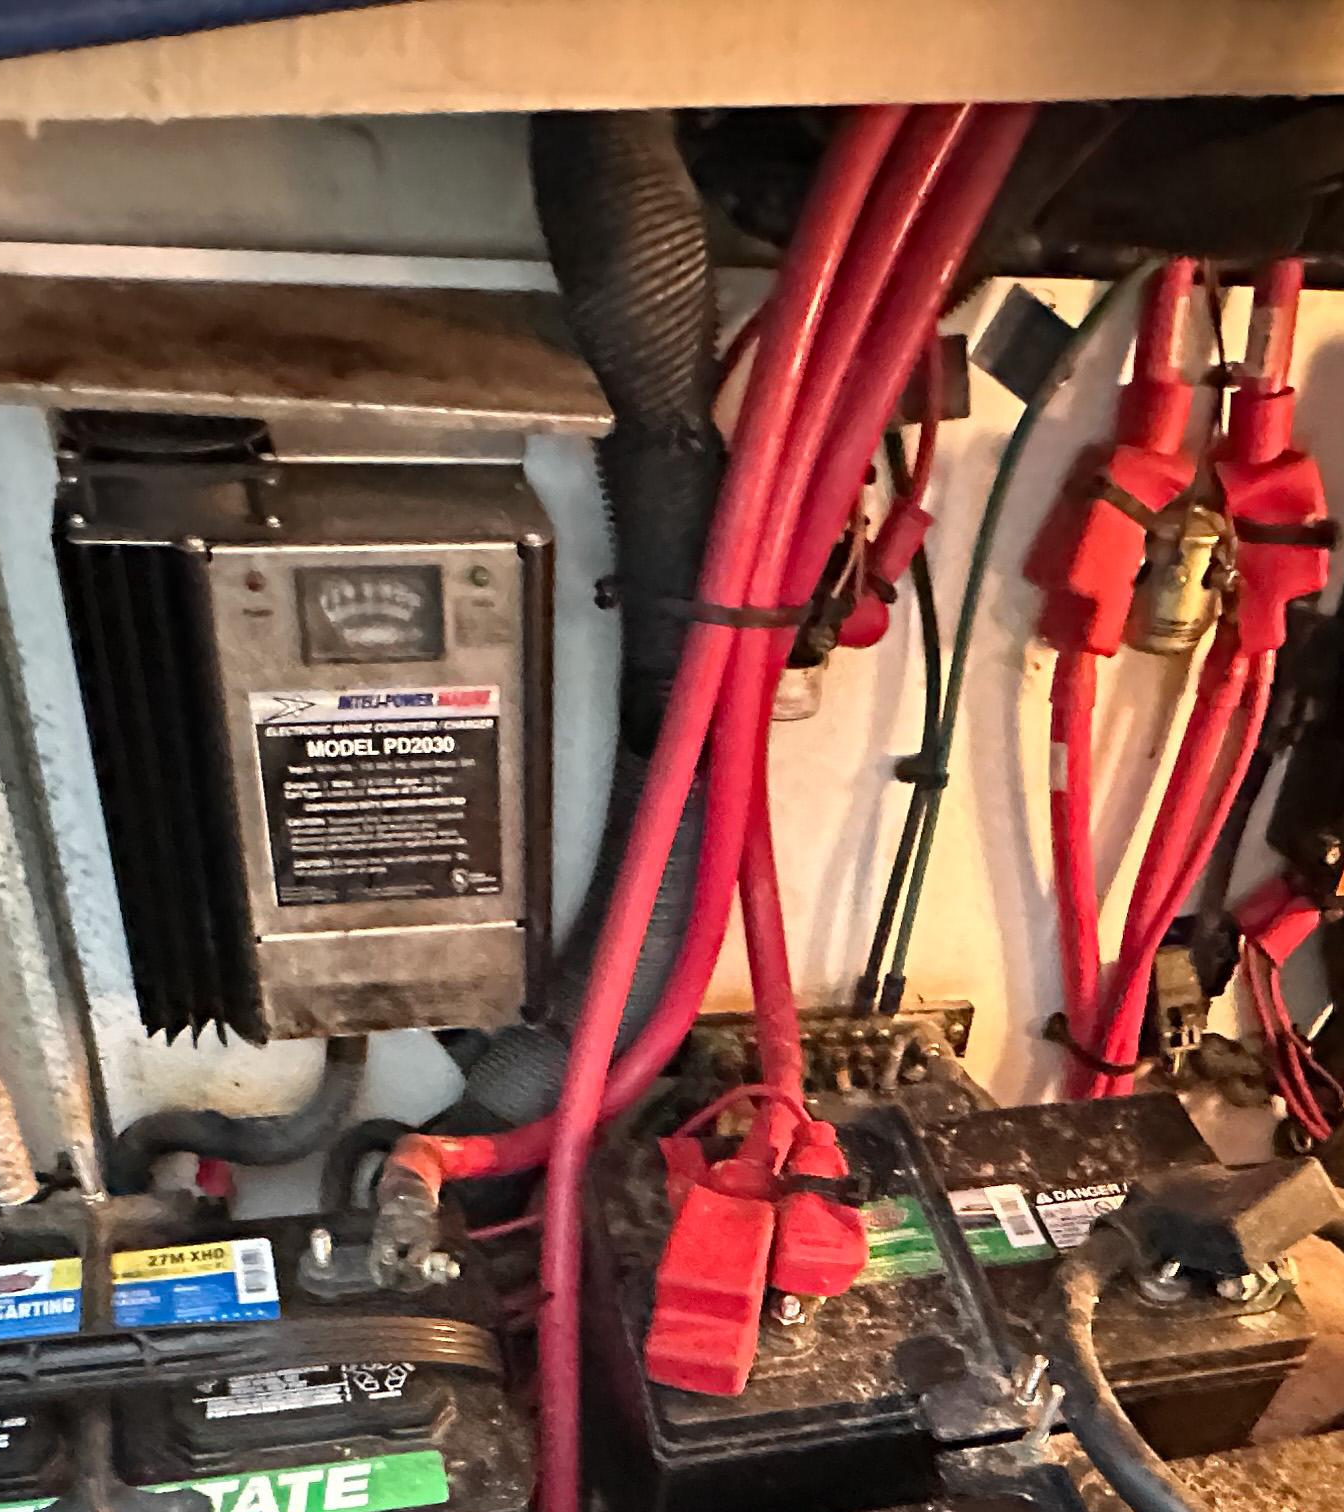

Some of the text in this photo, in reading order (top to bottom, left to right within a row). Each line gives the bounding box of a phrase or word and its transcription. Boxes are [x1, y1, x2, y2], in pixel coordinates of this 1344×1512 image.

[307, 736, 455, 758] MODEL PD2030
[1052, 1183, 1121, 1201] DANGER
